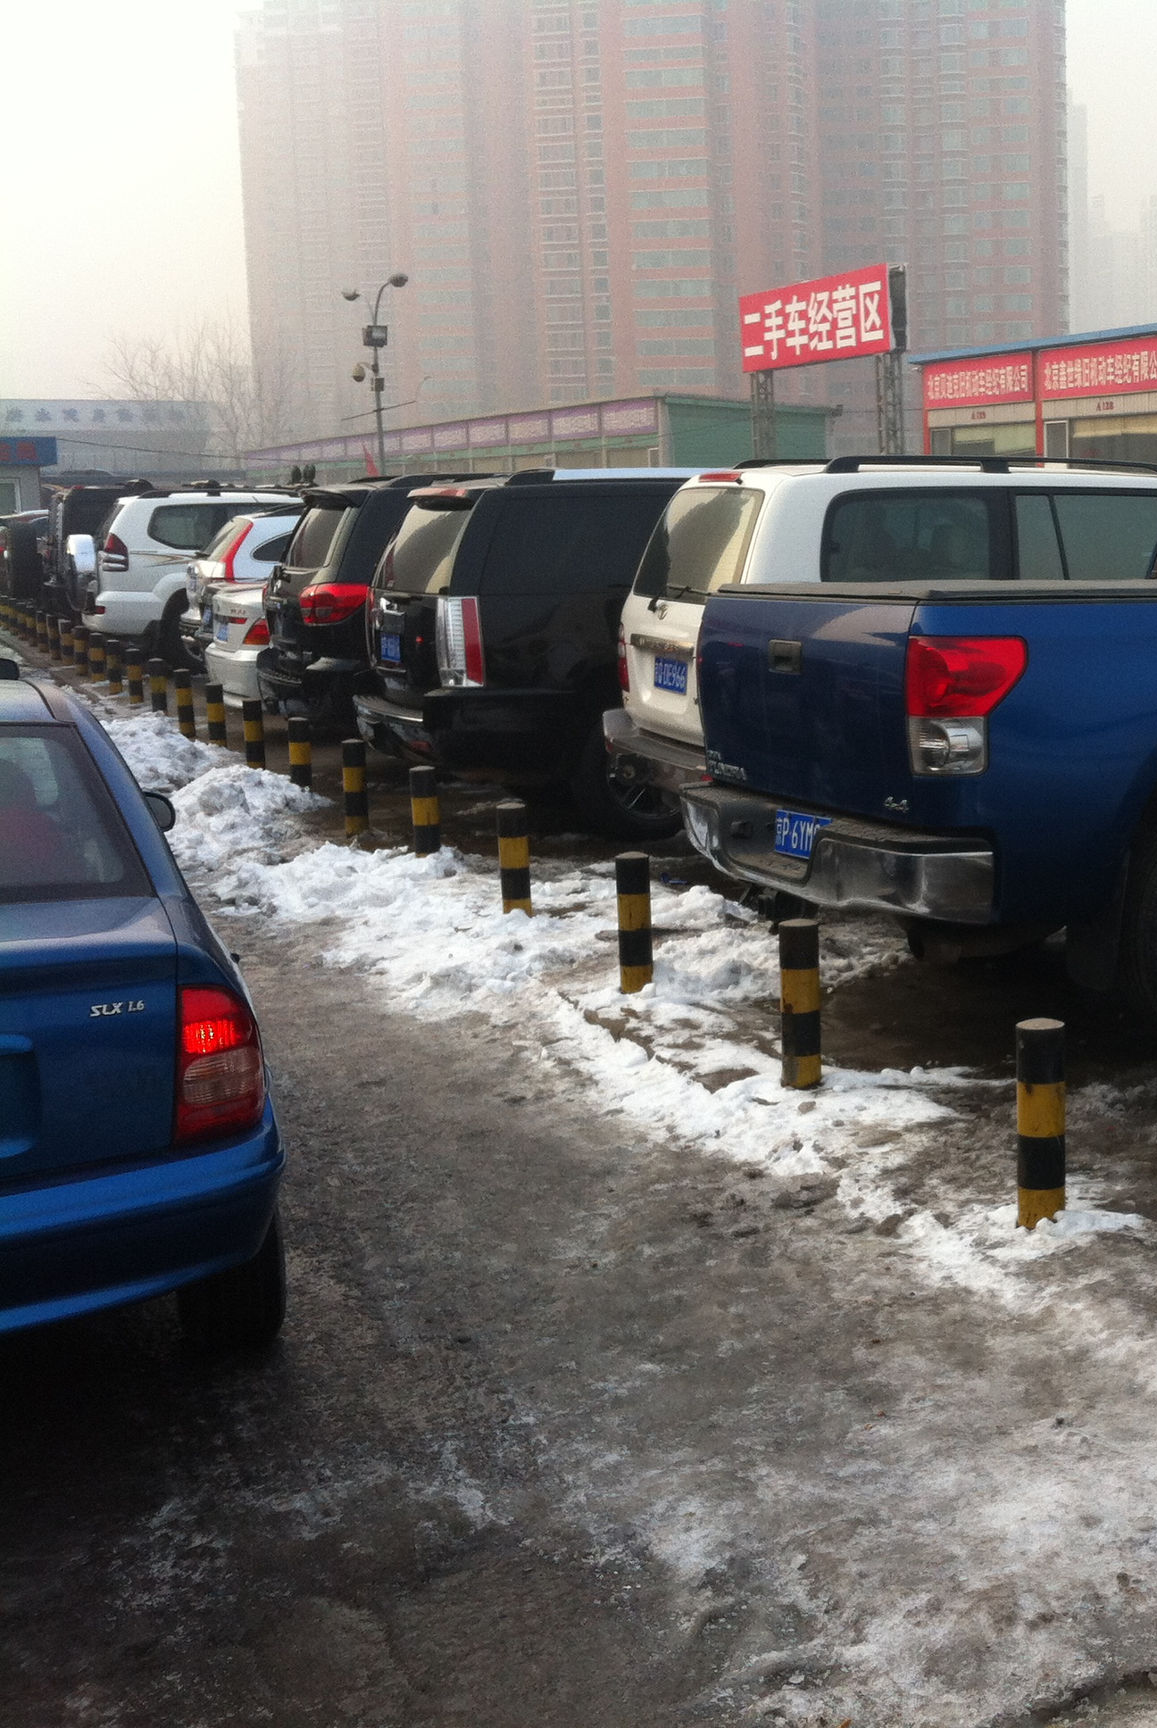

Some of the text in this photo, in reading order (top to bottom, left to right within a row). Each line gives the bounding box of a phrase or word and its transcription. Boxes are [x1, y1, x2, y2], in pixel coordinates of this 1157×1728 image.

[744, 281, 884, 361] 二手车经营区
[90, 1001, 123, 1017] SLX
